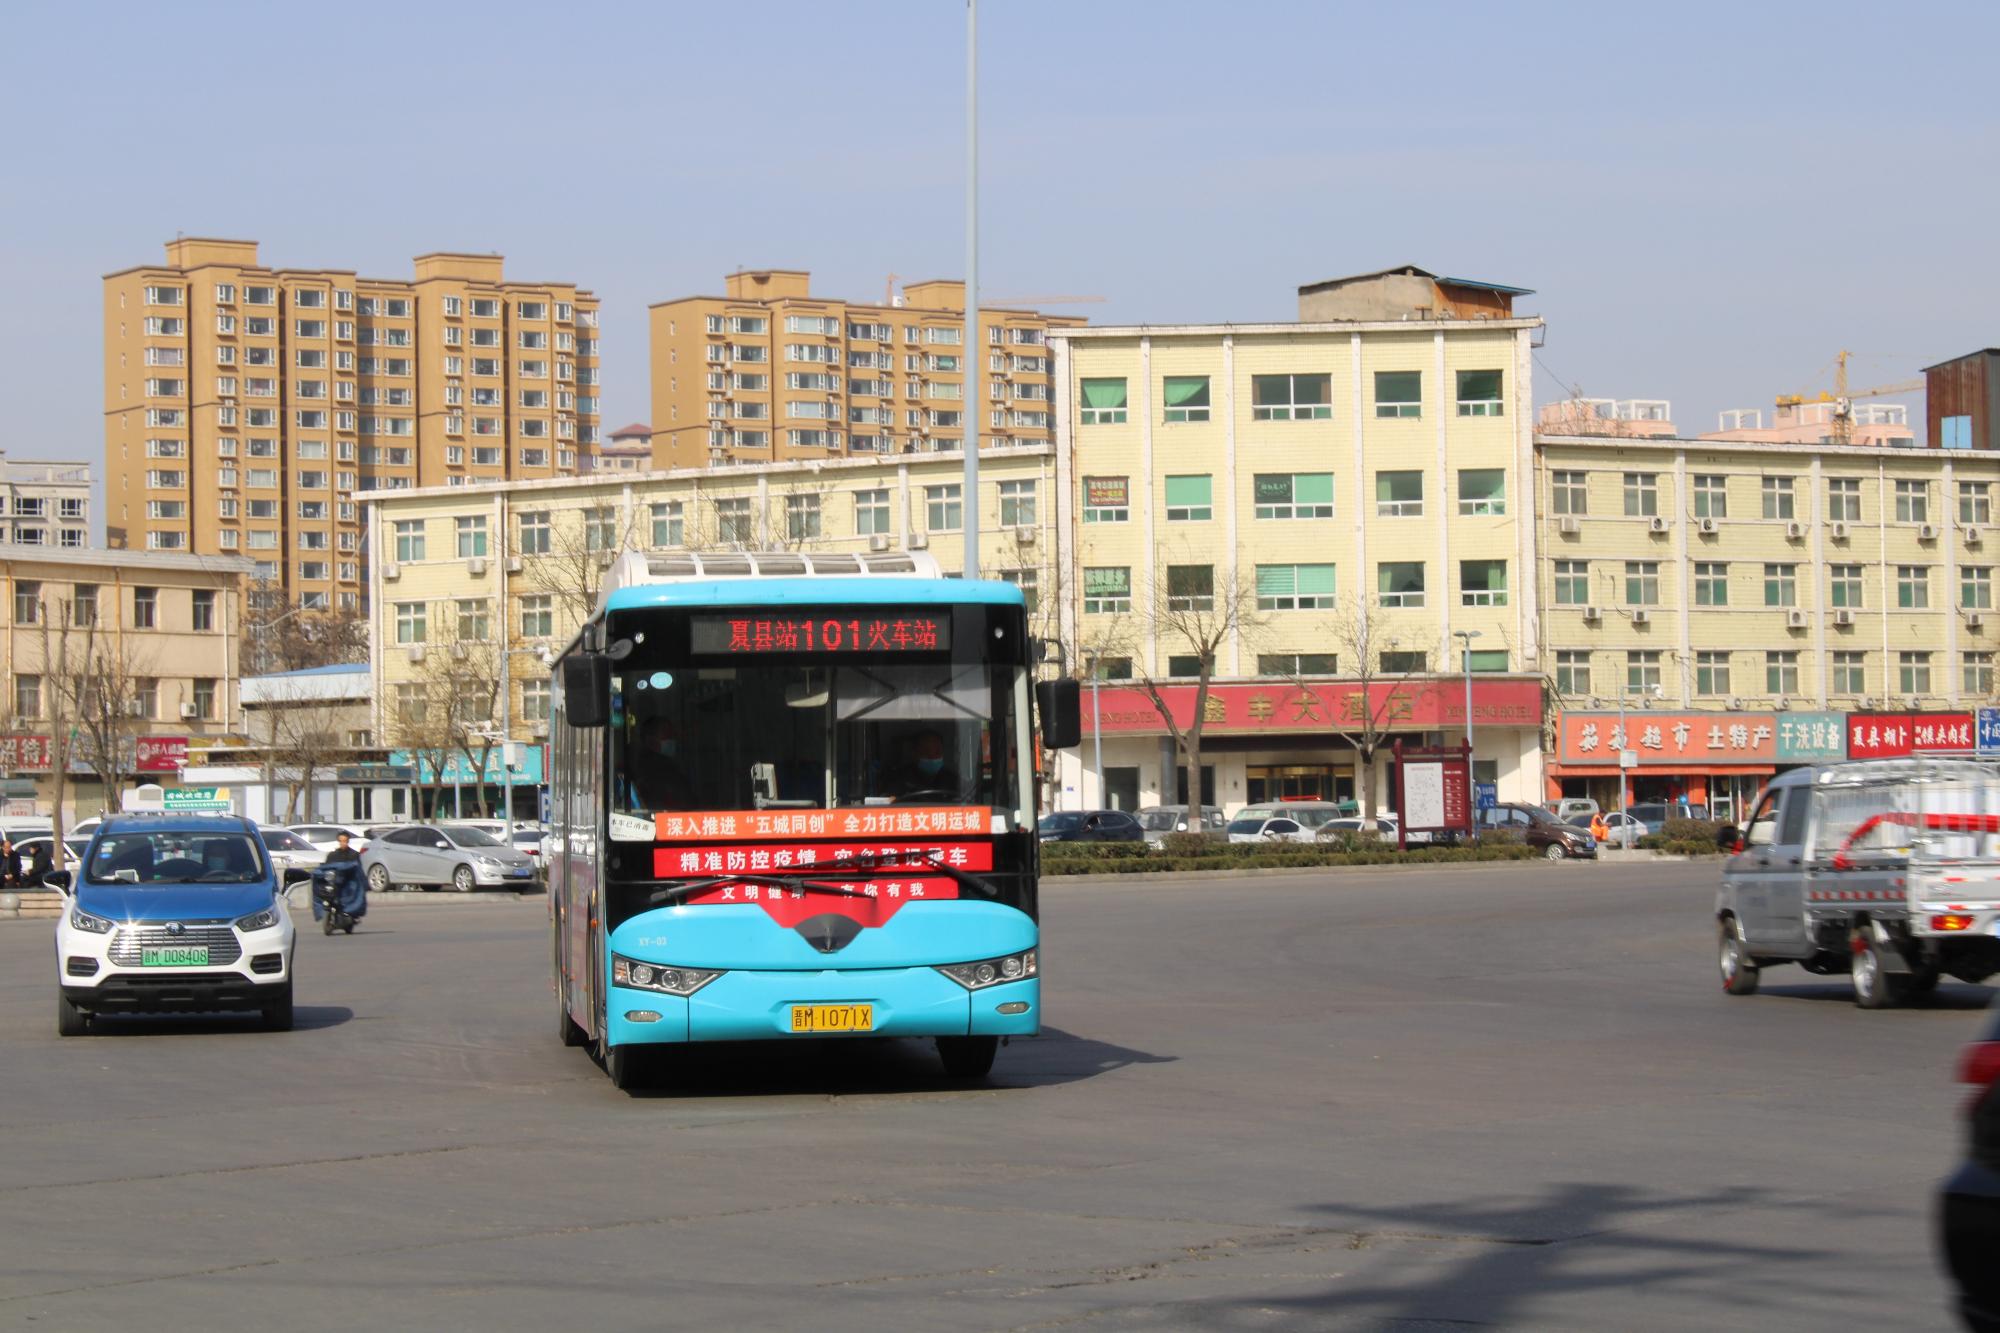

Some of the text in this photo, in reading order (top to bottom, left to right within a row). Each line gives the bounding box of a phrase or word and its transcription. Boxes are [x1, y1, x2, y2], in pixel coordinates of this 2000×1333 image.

[1202, 692, 1413, 723] 鑫丰大酒店
[1707, 725, 1771, 750] 土特产
[1781, 722, 1840, 751] 干洗设备
[680, 849, 817, 873] 精准防控疫情
[840, 882, 925, 899] 有你有我
